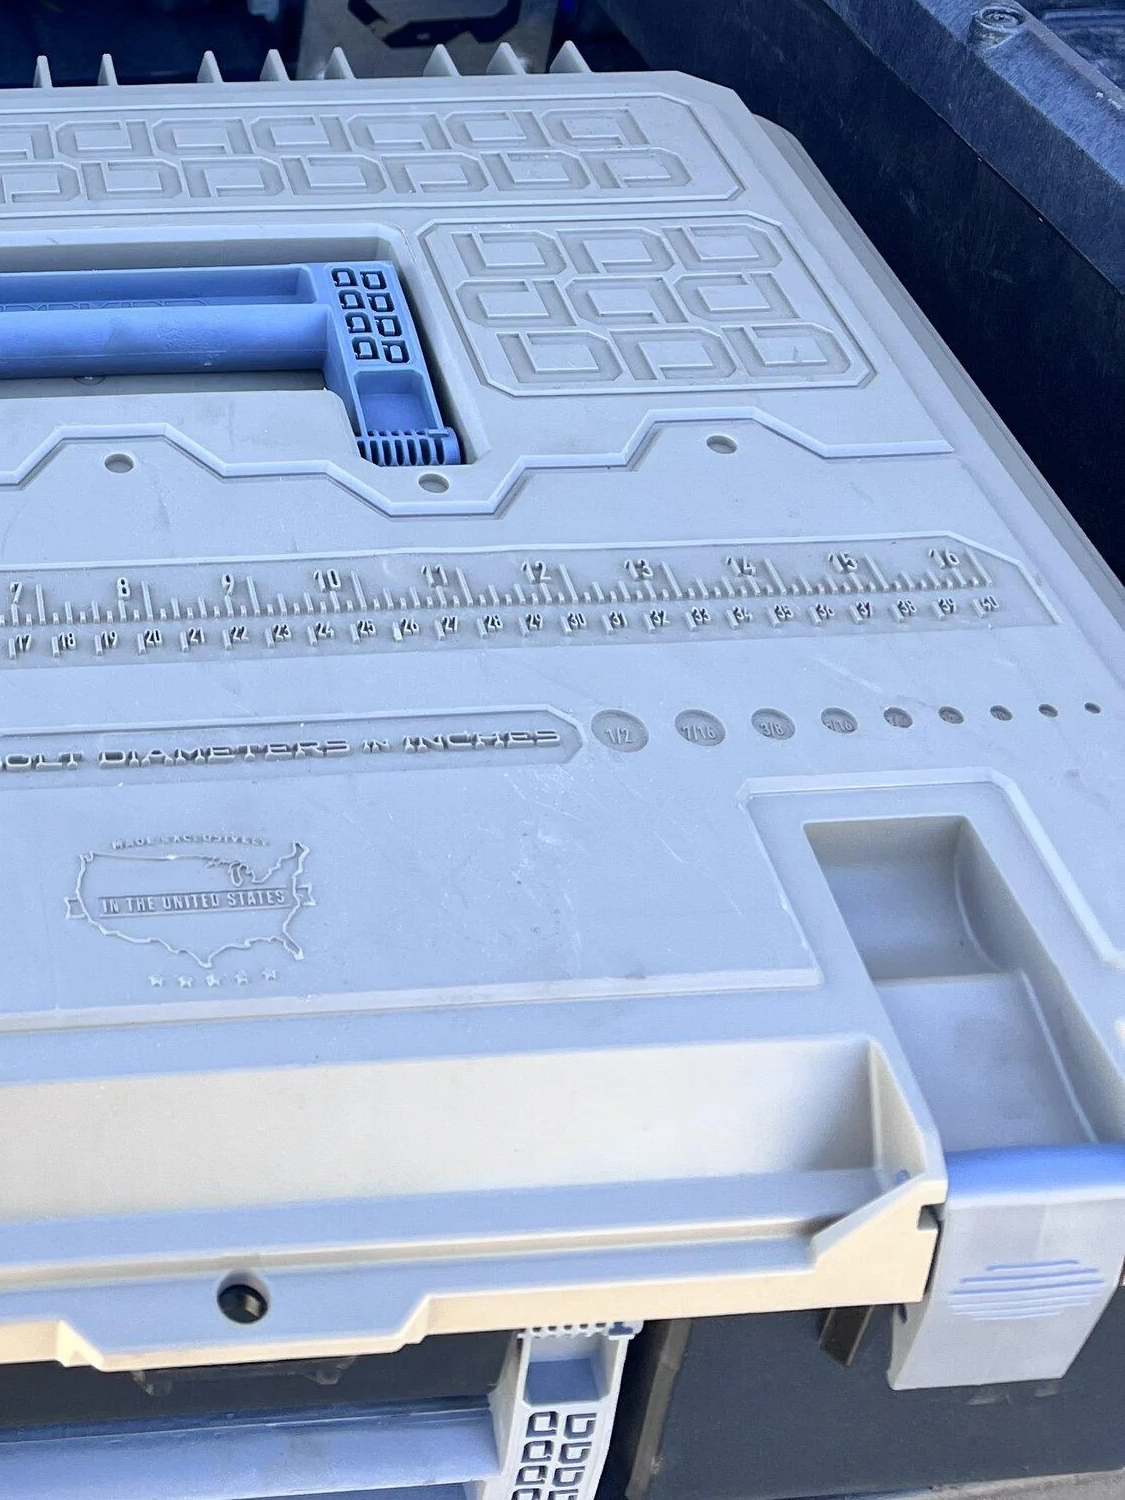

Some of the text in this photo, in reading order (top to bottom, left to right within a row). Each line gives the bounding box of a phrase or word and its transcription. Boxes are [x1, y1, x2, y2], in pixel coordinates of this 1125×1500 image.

[10, 581, 23, 604] 7
[117, 577, 130, 599] 8
[222, 573, 235, 596] 9
[313, 569, 341, 592] 10
[421, 565, 448, 587] 11
[522, 559, 552, 584] 12
[625, 559, 653, 581] 13
[727, 556, 756, 577] 14
[828, 551, 858, 573] 15
[929, 548, 960, 569] 16
[16, 634, 32, 651] 17
[59, 631, 76, 650] 18
[101, 630, 118, 649] 19
[144, 628, 163, 647] 20
[188, 627, 206, 645] 21
[231, 625, 249, 643] 22
[274, 623, 292, 641] 23
[316, 620, 335, 639] 24
[357, 619, 376, 637] 25
[401, 617, 420, 635] 26
[442, 615, 458, 633] 27
[484, 613, 503, 631] 28
[526, 612, 544, 631] 29
[568, 611, 588, 629] 30
[610, 610, 629, 628] 31
[650, 608, 671, 627] 32
[691, 606, 711, 625] 33
[732, 605, 753, 623] 34
[774, 604, 794, 621] 35
[815, 602, 836, 620] 36
[605, 727, 634, 745] 1/2
[682, 724, 716, 742] 7/16
[759, 722, 785, 738] 3/8
[97, 740, 350, 769] DIAMETERS
[362, 739, 392, 754] IN
[402, 728, 562, 755] INCHES
[111, 834, 271, 849] MADE EXCLUSIVELY
[102, 889, 285, 913] IN THE UNITED STATES
